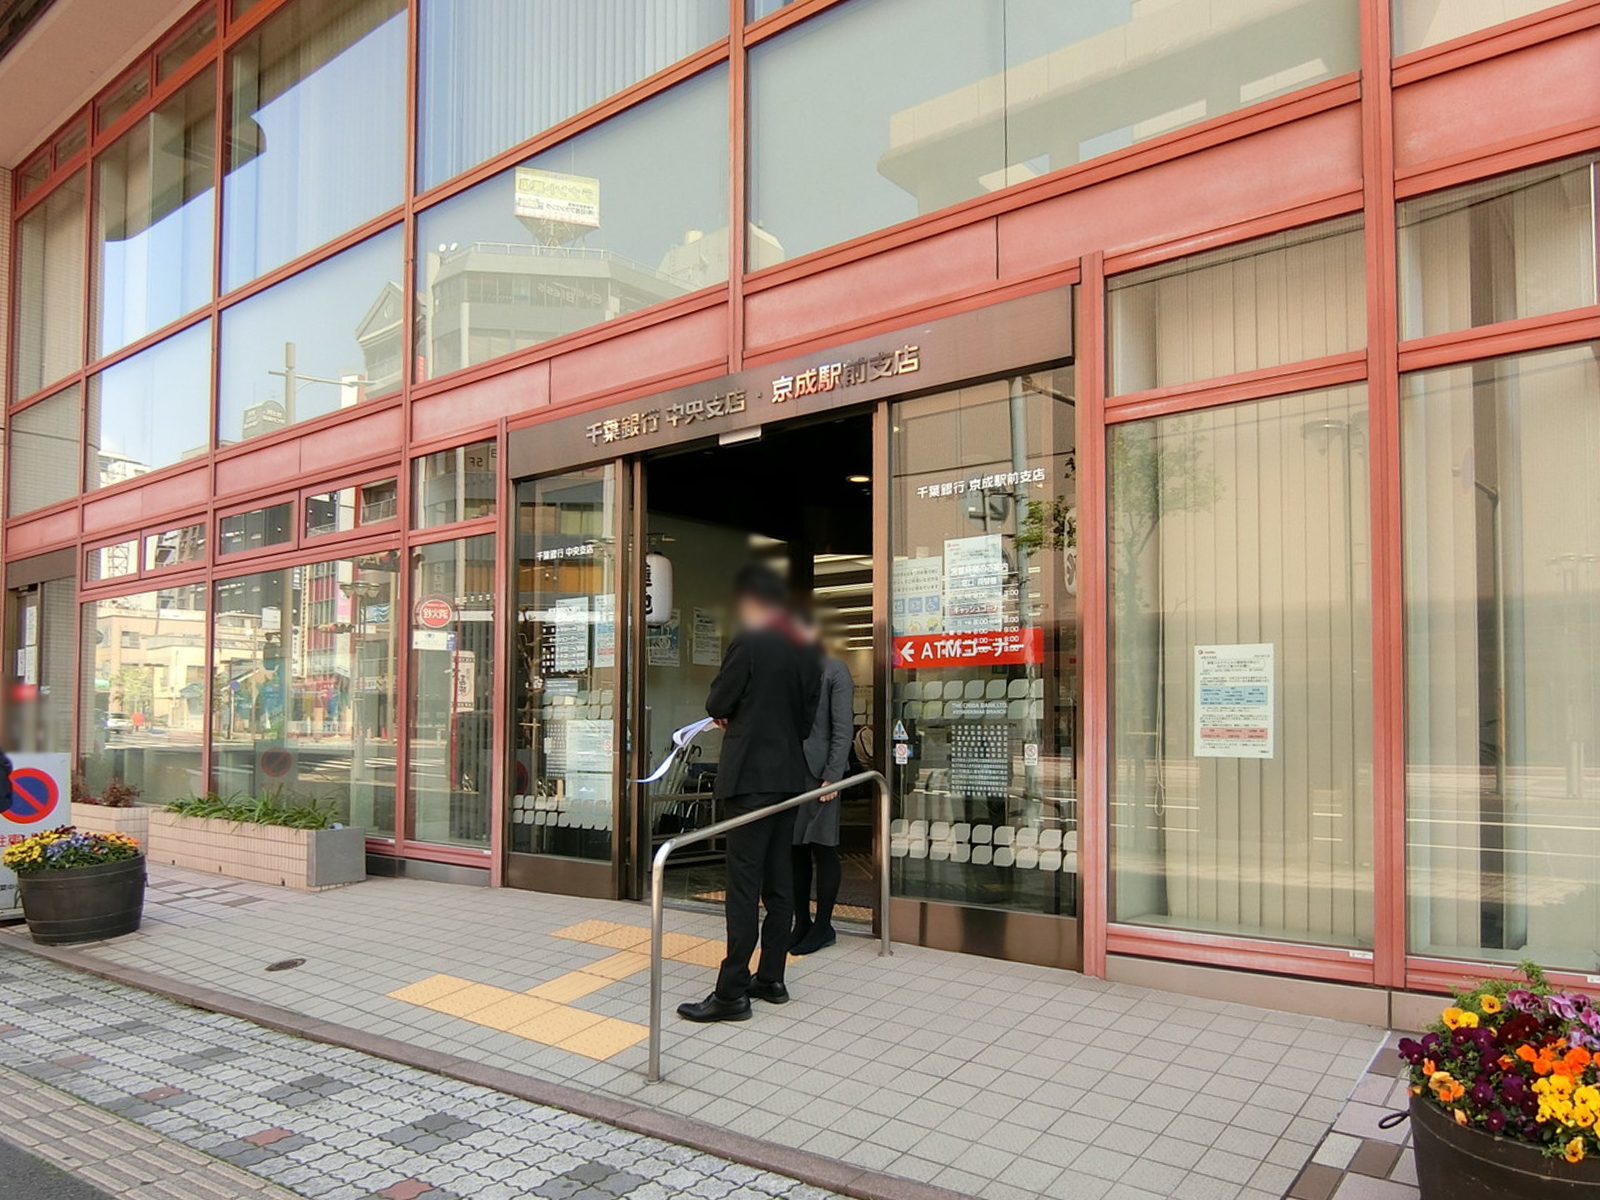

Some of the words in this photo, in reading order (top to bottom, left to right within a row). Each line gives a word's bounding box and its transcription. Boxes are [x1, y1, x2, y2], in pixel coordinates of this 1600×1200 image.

[585, 409, 660, 447] 千葉銀行
[665, 388, 748, 428] 中央支店
[770, 344, 921, 404] 京成駅前支店
[916, 480, 965, 499] 千葉銀行
[968, 467, 1046, 492] 京成駅前支店
[536, 547, 564, 562] 千葉銀行
[565, 544, 594, 556] 中央支店
[920, 638, 1025, 660] ATMコーナー
